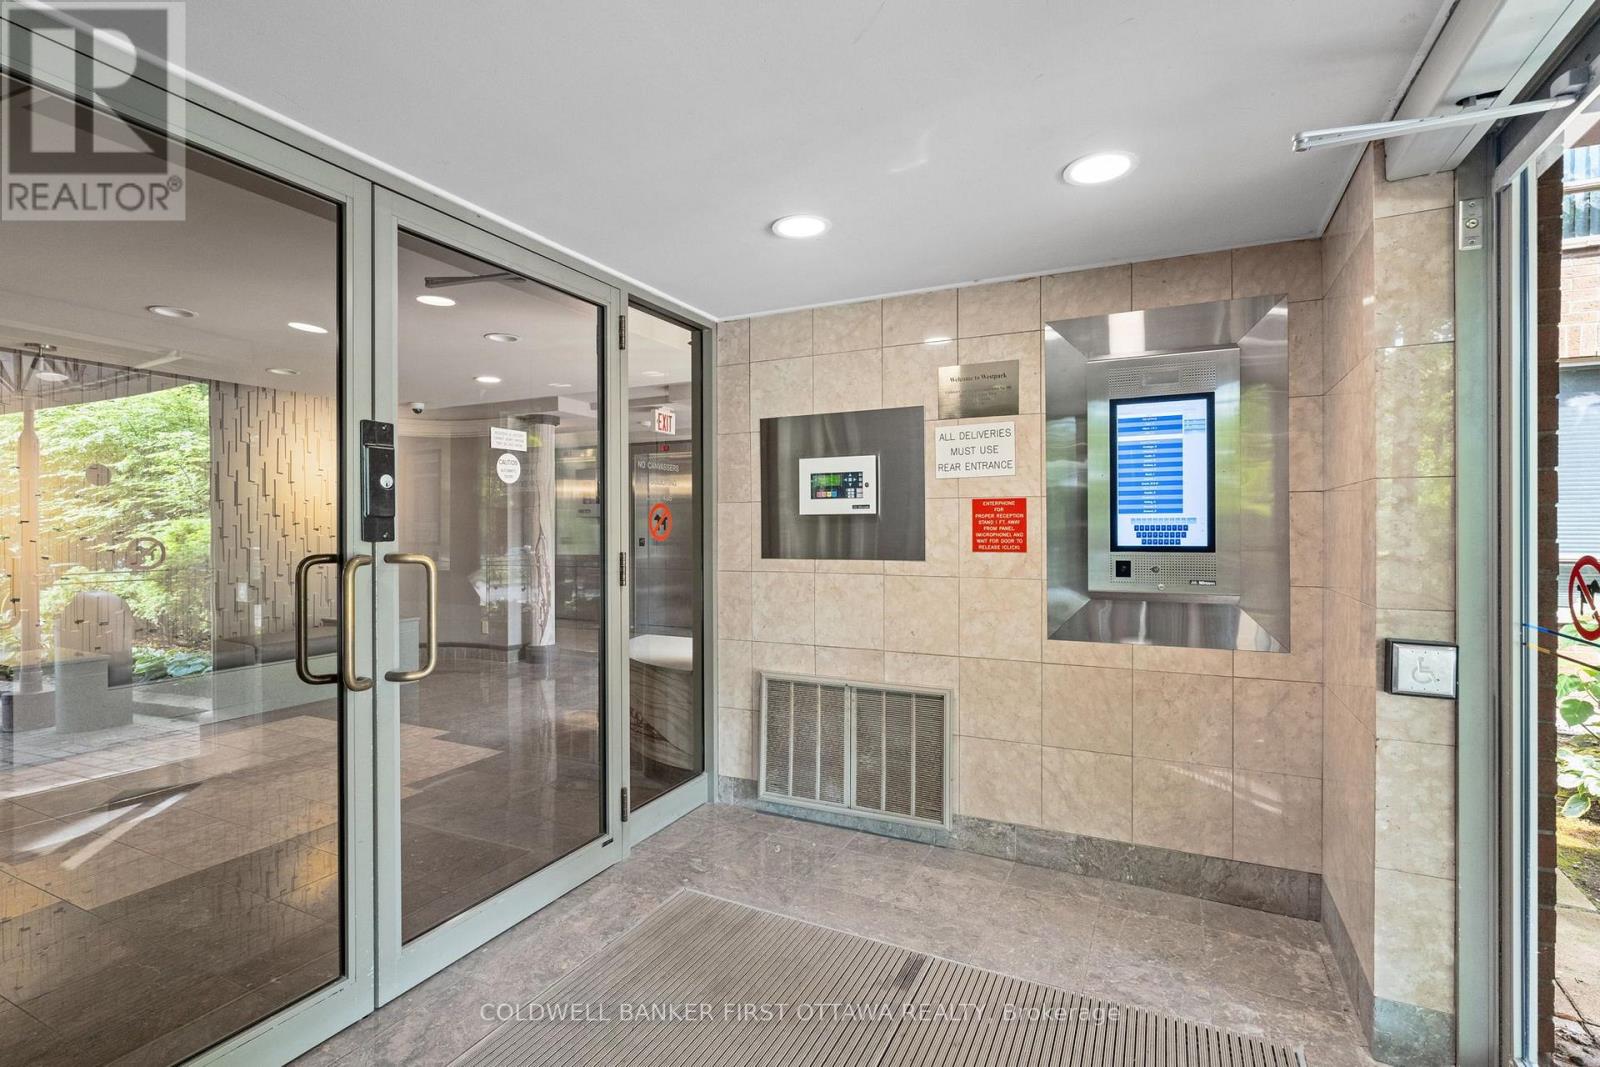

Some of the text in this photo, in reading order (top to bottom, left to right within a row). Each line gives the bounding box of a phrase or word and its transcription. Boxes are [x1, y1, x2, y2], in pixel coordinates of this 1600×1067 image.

[657, 412, 672, 433] EXIT
[939, 428, 1012, 442] ALL DELIVERIES
[950, 444, 999, 456] MUST USE
[637, 461, 680, 472] NO CANVASSERS
[937, 460, 1013, 472] REAR ENTRANCE
